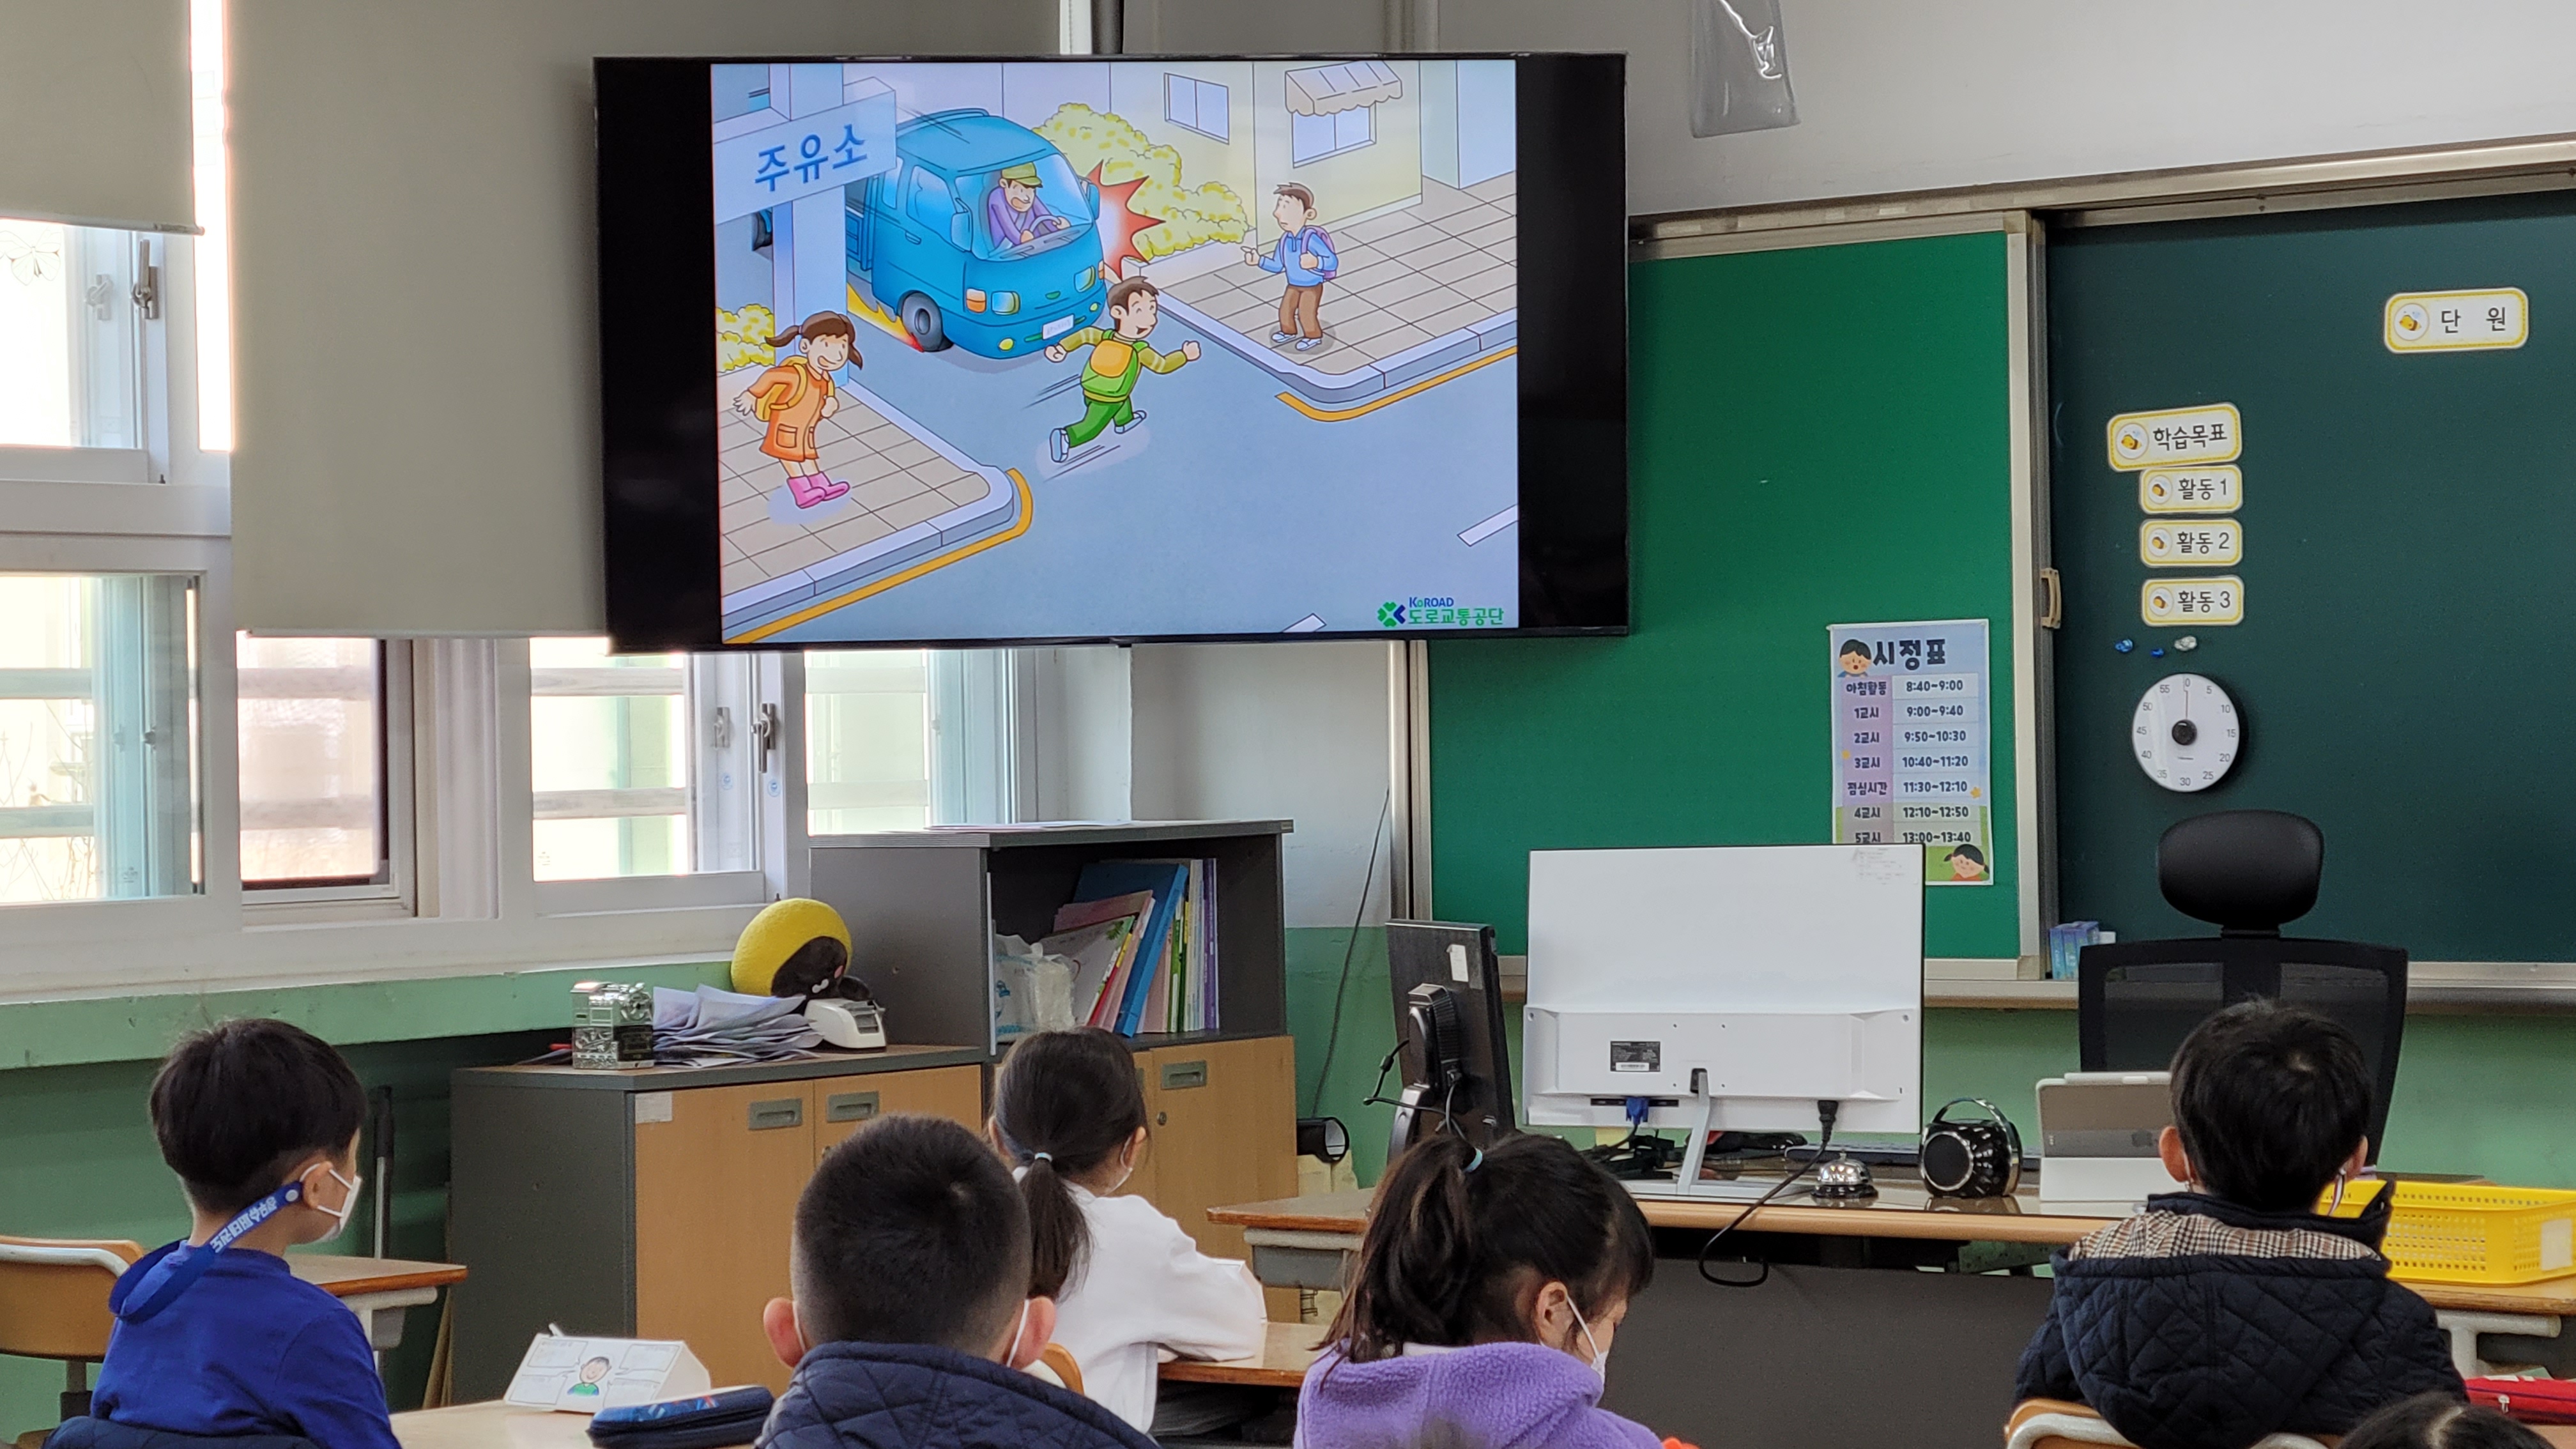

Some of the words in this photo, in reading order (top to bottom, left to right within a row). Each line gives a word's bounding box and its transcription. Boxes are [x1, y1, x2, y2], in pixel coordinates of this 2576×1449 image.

[755, 123, 868, 192] 주유소
[2441, 309, 2461, 334] 단
[2486, 307, 2506, 332] 원
[2153, 423, 2227, 450] 학습목표
[2178, 478, 2215, 500] 활동
[2220, 479, 2227, 496] 1
[2176, 531, 2214, 554] 활동
[2219, 532, 2230, 549] 2
[2177, 590, 2215, 613] 활동
[2220, 591, 2231, 608] 3
[1408, 608, 1504, 626] 도로교통공단
[1873, 639, 1946, 671] 시정표
[1846, 681, 1887, 695] 아침활동
[1906, 680, 1963, 692] 8:40~9:00
[2159, 684, 2170, 693] 55
[2184, 678, 2191, 687] 0
[2206, 686, 2212, 694] 5
[1854, 707, 1879, 718] 1교시
[1906, 706, 1963, 717] 9:00~9:40
[2142, 702, 2153, 711] 50
[2221, 705, 2231, 713] 10
[2136, 726, 2147, 735] 45
[2227, 729, 2236, 738] 15
[1854, 732, 1880, 744] 2교시
[1904, 730, 1966, 742] 9:50~10:30
[2141, 750, 2152, 759] 40
[2219, 753, 2230, 762] 20
[1854, 757, 1880, 768] 3교시
[1902, 756, 1968, 767] 10:40~11:20
[2157, 769, 2168, 779] 35
[2202, 771, 2214, 779] 25
[1847, 781, 1888, 795] 점심시간
[1903, 781, 1968, 793] 11:30~12:10
[2179, 778, 2191, 786] 30
[1854, 807, 1880, 818] 4교시
[1903, 806, 1968, 818] 12:10~12:50
[1855, 832, 1881, 843] 5교시
[1902, 832, 1971, 843] 13:00~13:40
